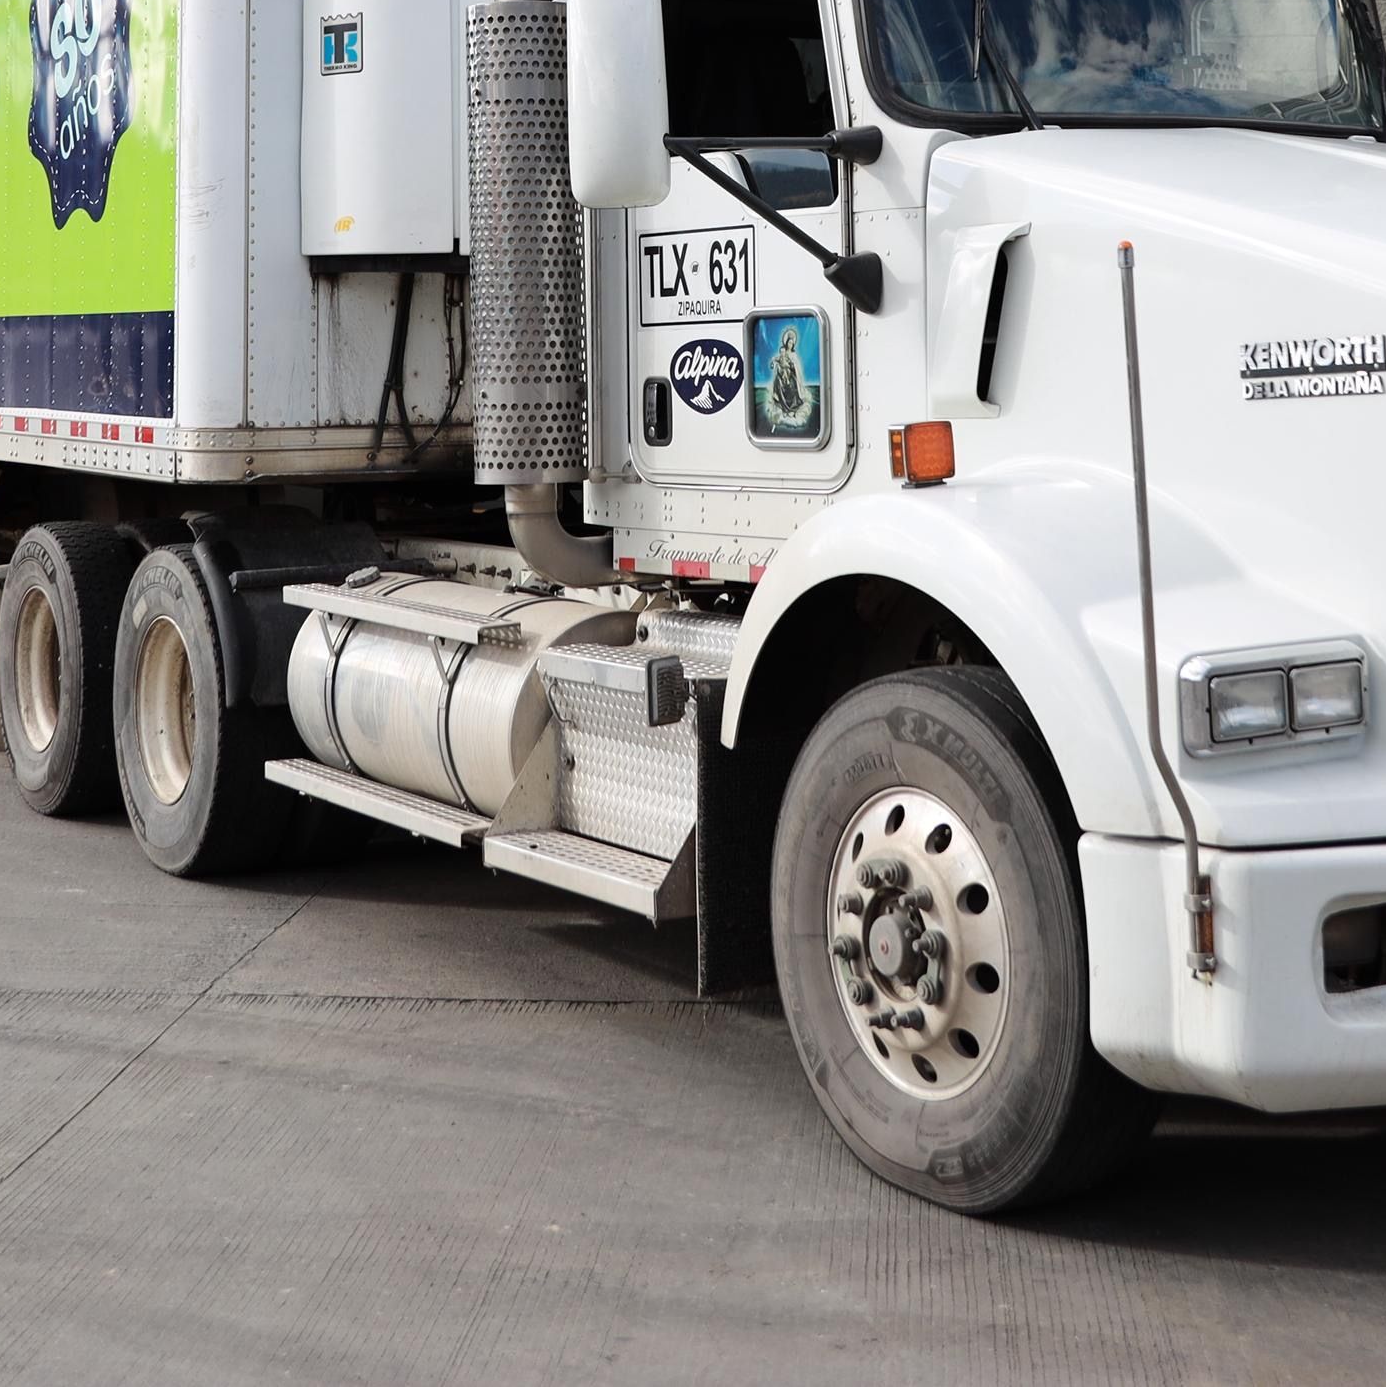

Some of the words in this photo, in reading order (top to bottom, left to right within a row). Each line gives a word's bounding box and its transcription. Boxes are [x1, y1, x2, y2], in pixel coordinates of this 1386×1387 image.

[59, 53, 114, 160] años
[644, 242, 690, 298] TLX
[709, 238, 749, 294] 631
[678, 299, 722, 316] ZIPAQUIRA
[674, 345, 740, 386] alpina
[1238, 335, 1386, 371] KENWORTH
[1293, 371, 1385, 397] MONTAÑA
[728, 547, 747, 564] de
